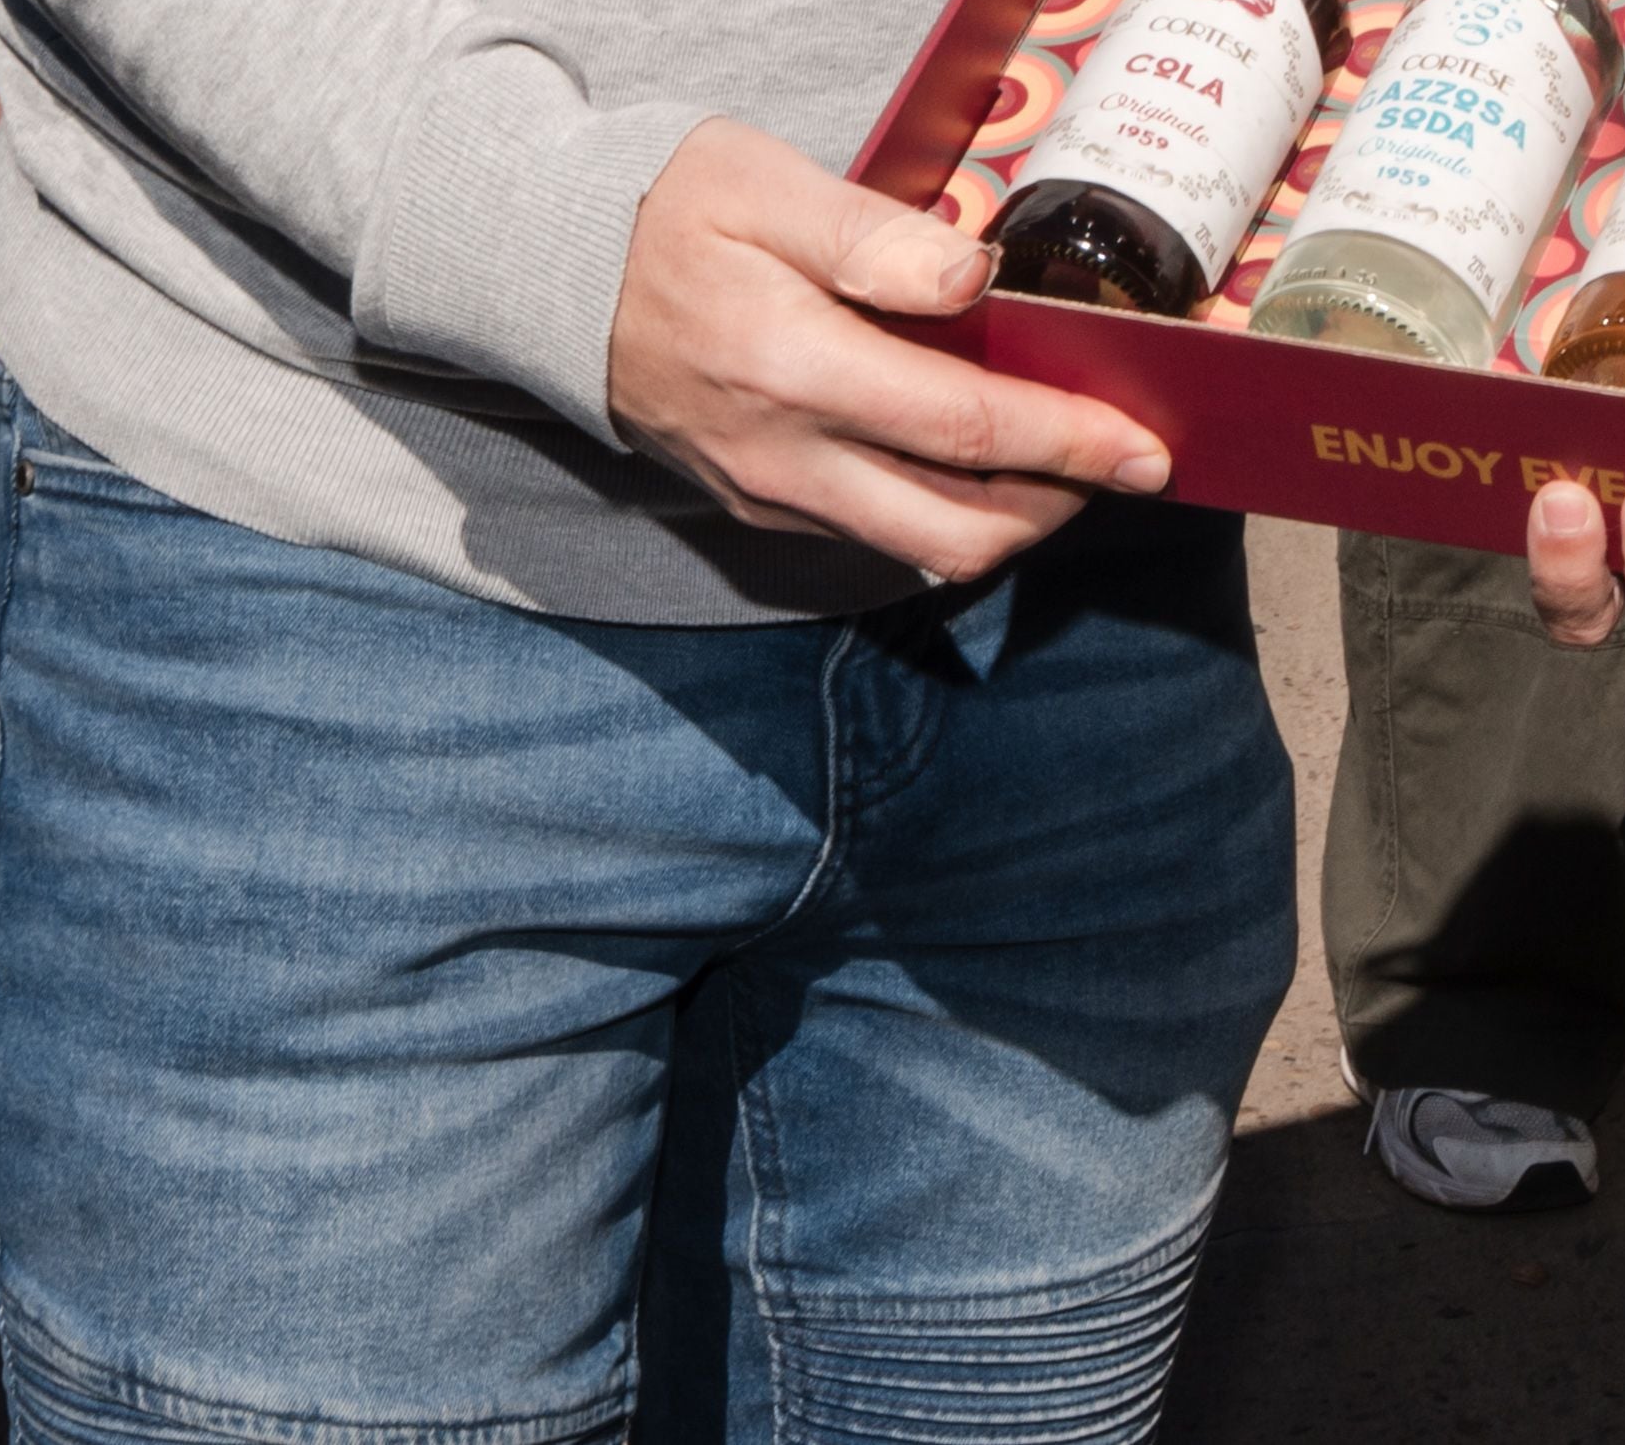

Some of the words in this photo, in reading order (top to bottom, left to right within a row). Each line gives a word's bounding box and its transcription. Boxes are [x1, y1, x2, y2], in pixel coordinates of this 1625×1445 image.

[1148, 15, 1260, 69] CORTESE
[1124, 53, 1225, 109] COLA
[1400, 52, 1517, 98] CORTESE
[1098, 92, 1211, 147] Originale
[1115, 122, 1170, 151] 1959
[1355, 78, 1528, 153] GAZZOSA
[1375, 106, 1475, 150] SODA
[1357, 134, 1473, 178] Originale
[1376, 164, 1431, 188] 1959
[1310, 424, 1505, 486] ENJOY
